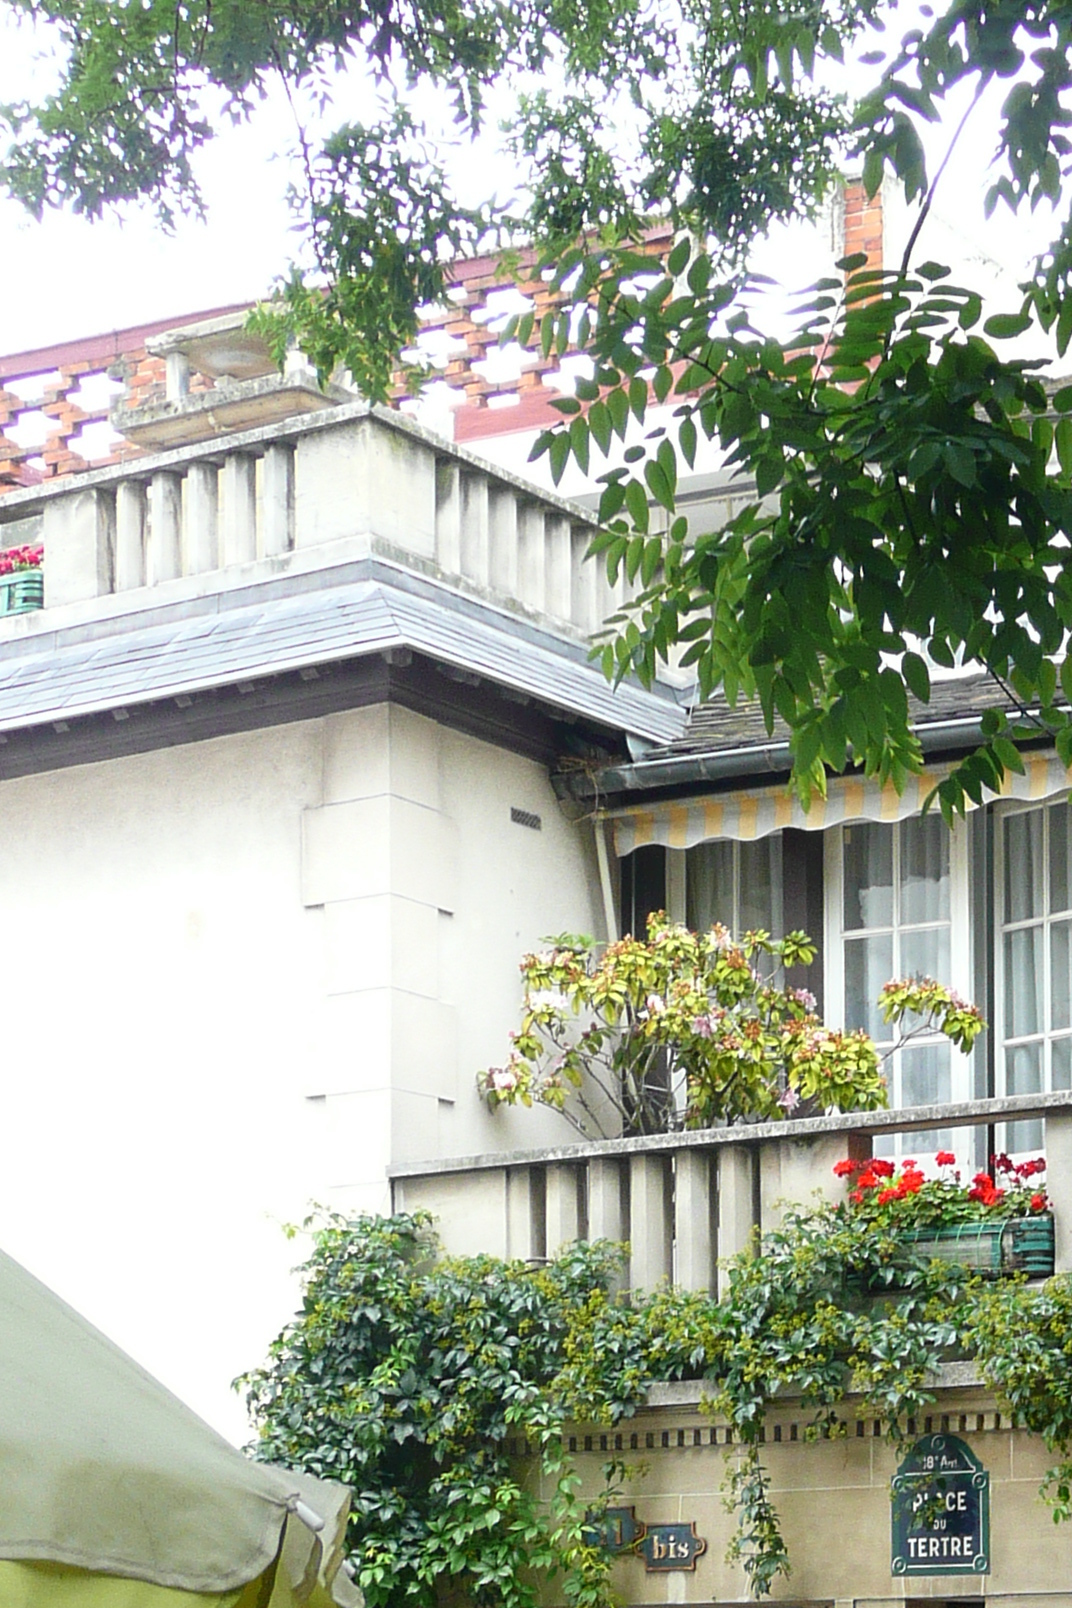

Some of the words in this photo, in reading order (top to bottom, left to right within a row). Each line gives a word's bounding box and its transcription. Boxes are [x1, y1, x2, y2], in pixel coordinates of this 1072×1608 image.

[912, 1490, 967, 1512] PCE
[653, 1534, 689, 1559] bis
[907, 1535, 973, 1558] TERTRE
